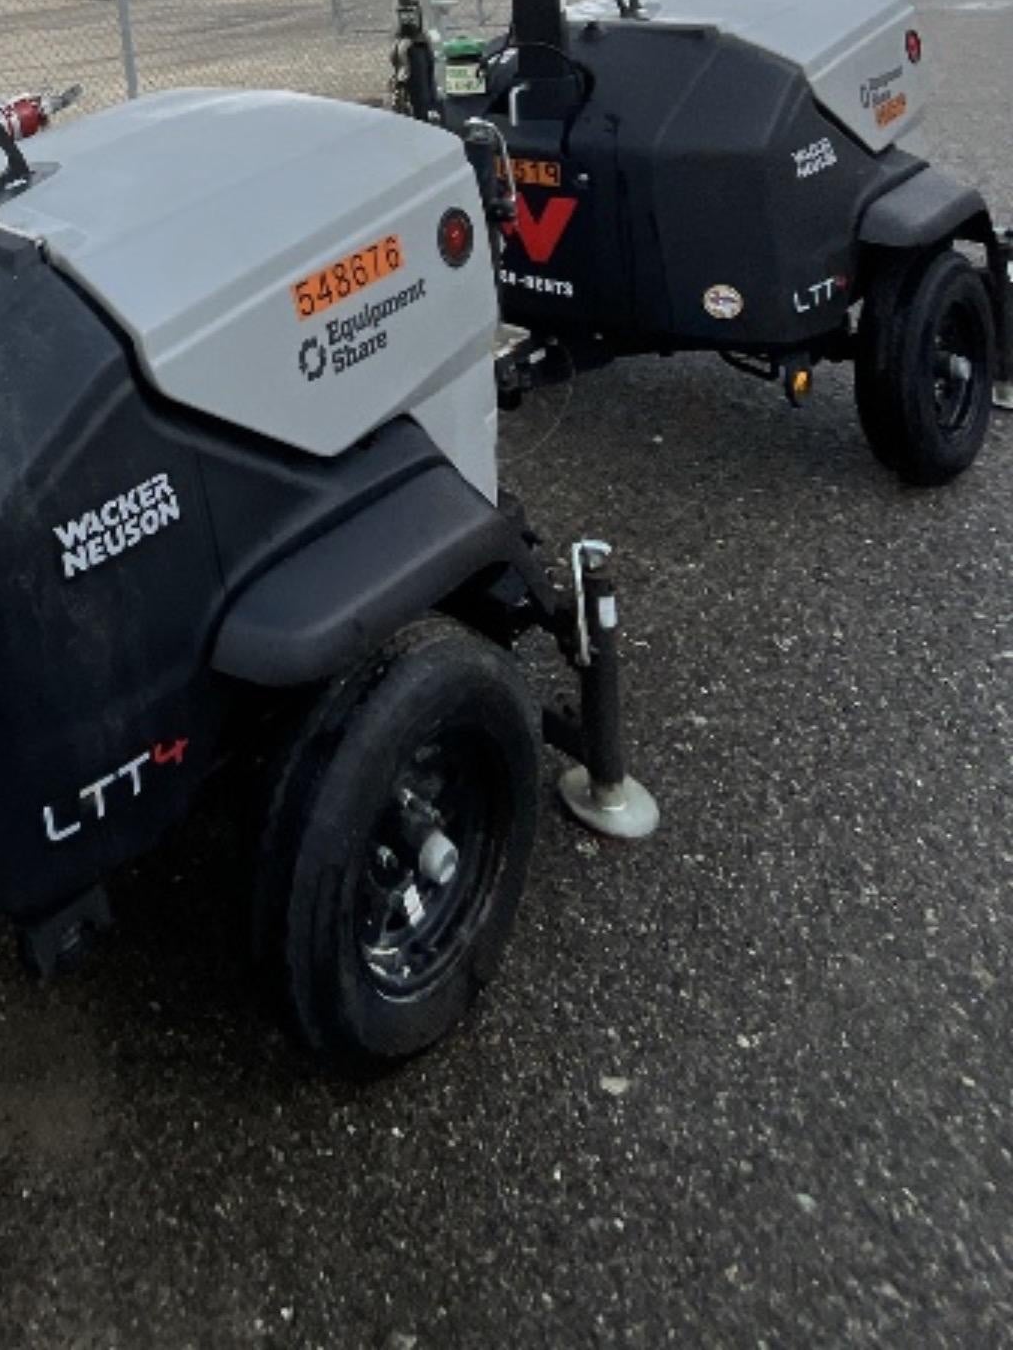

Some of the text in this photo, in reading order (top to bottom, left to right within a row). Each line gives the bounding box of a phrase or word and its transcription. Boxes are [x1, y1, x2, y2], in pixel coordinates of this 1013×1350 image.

[295, 235, 401, 317] 548676
[326, 277, 428, 346] Equipment
[331, 330, 388, 375] Share
[51, 472, 175, 550] WACKER
[61, 493, 181, 579] NEUSON
[42, 736, 189, 842] LTT4
